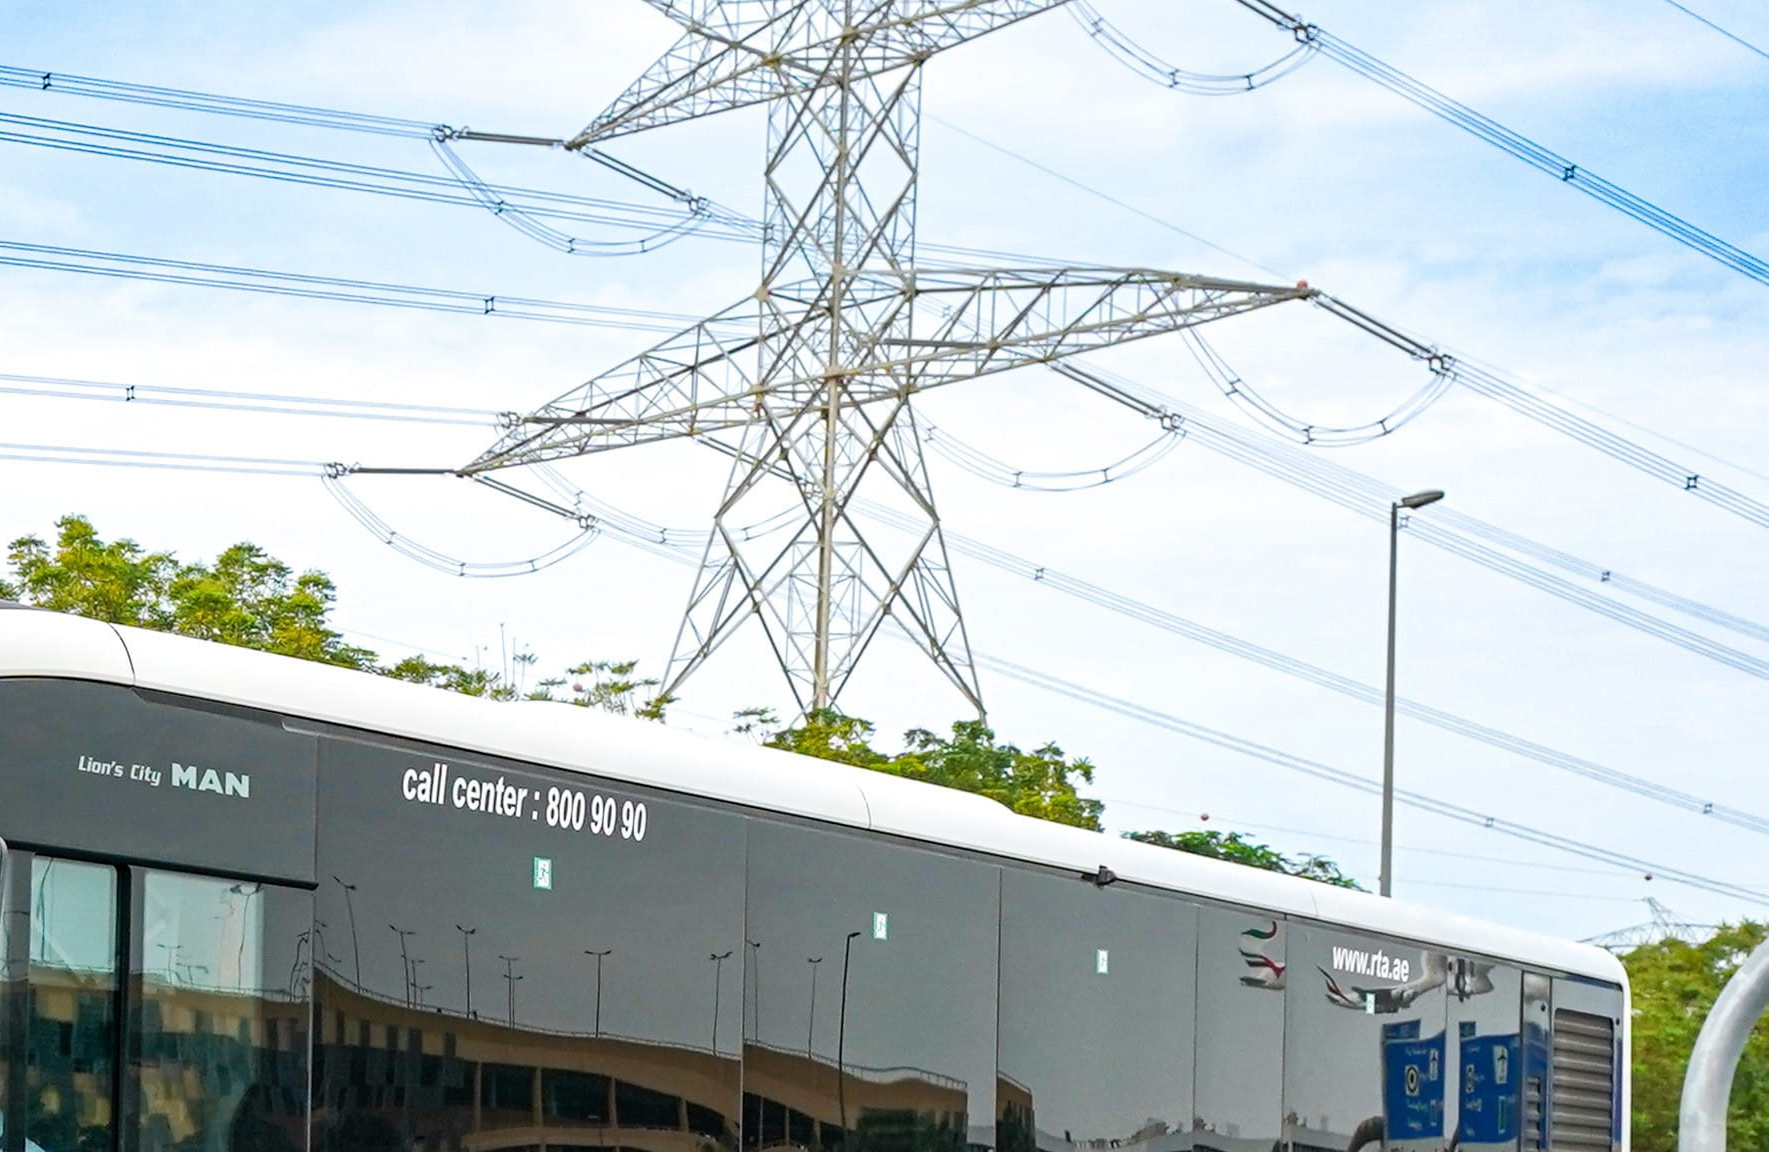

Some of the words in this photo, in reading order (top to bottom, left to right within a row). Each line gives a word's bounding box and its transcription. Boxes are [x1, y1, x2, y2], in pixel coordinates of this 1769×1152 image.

[77, 755, 124, 778] Lion's
[131, 764, 162, 787] City
[171, 762, 250, 799] MAN
[402, 762, 448, 805] call
[452, 775, 528, 818] center
[546, 786, 586, 832] 800
[590, 794, 617, 837] 90
[620, 800, 647, 842] 90
[1332, 945, 1410, 983] www.rta.ae
